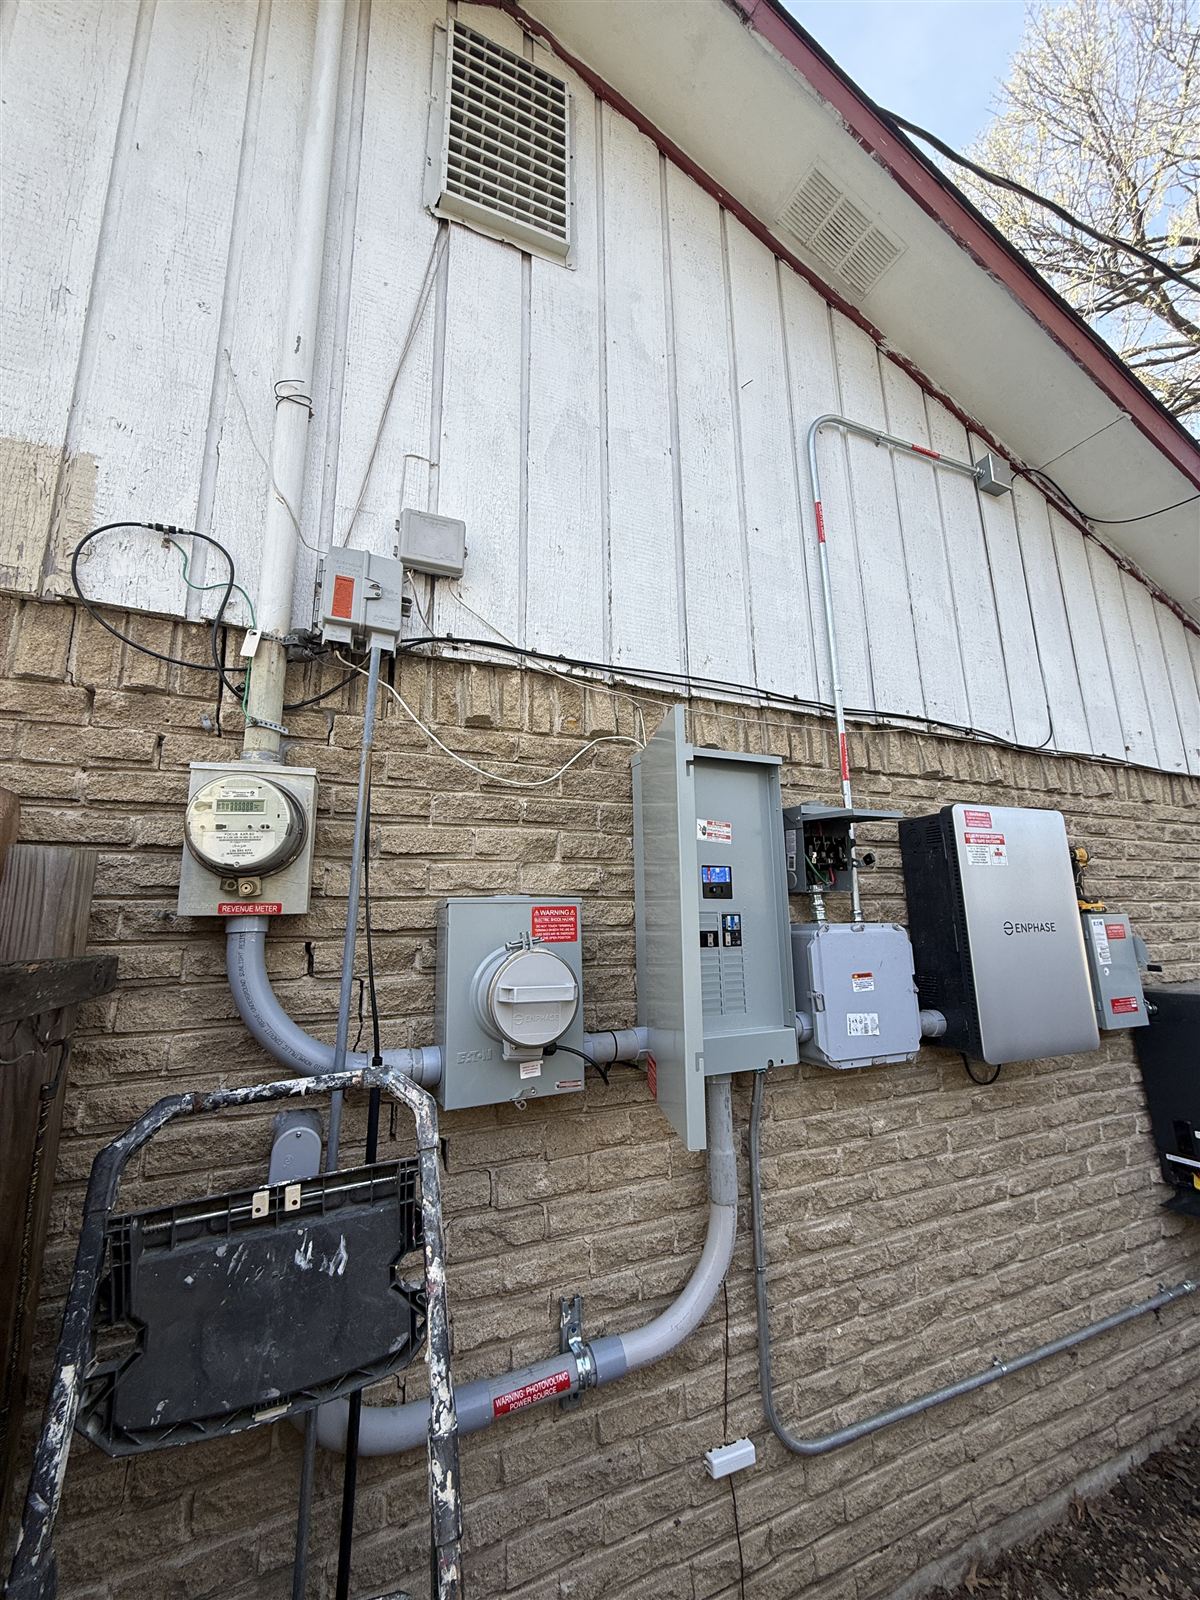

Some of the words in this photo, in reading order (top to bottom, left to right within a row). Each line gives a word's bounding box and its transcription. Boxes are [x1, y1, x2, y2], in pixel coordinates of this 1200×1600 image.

[222, 904, 254, 913] REVENUE
[255, 905, 278, 913] METER
[1014, 922, 1057, 933] ENPHASE
[526, 1013, 560, 1022] ENPHASE
[526, 1372, 569, 1395] PHOTOVOLTAIC
[509, 1397, 532, 1410] POWER
[533, 1387, 557, 1401] SOURCE
